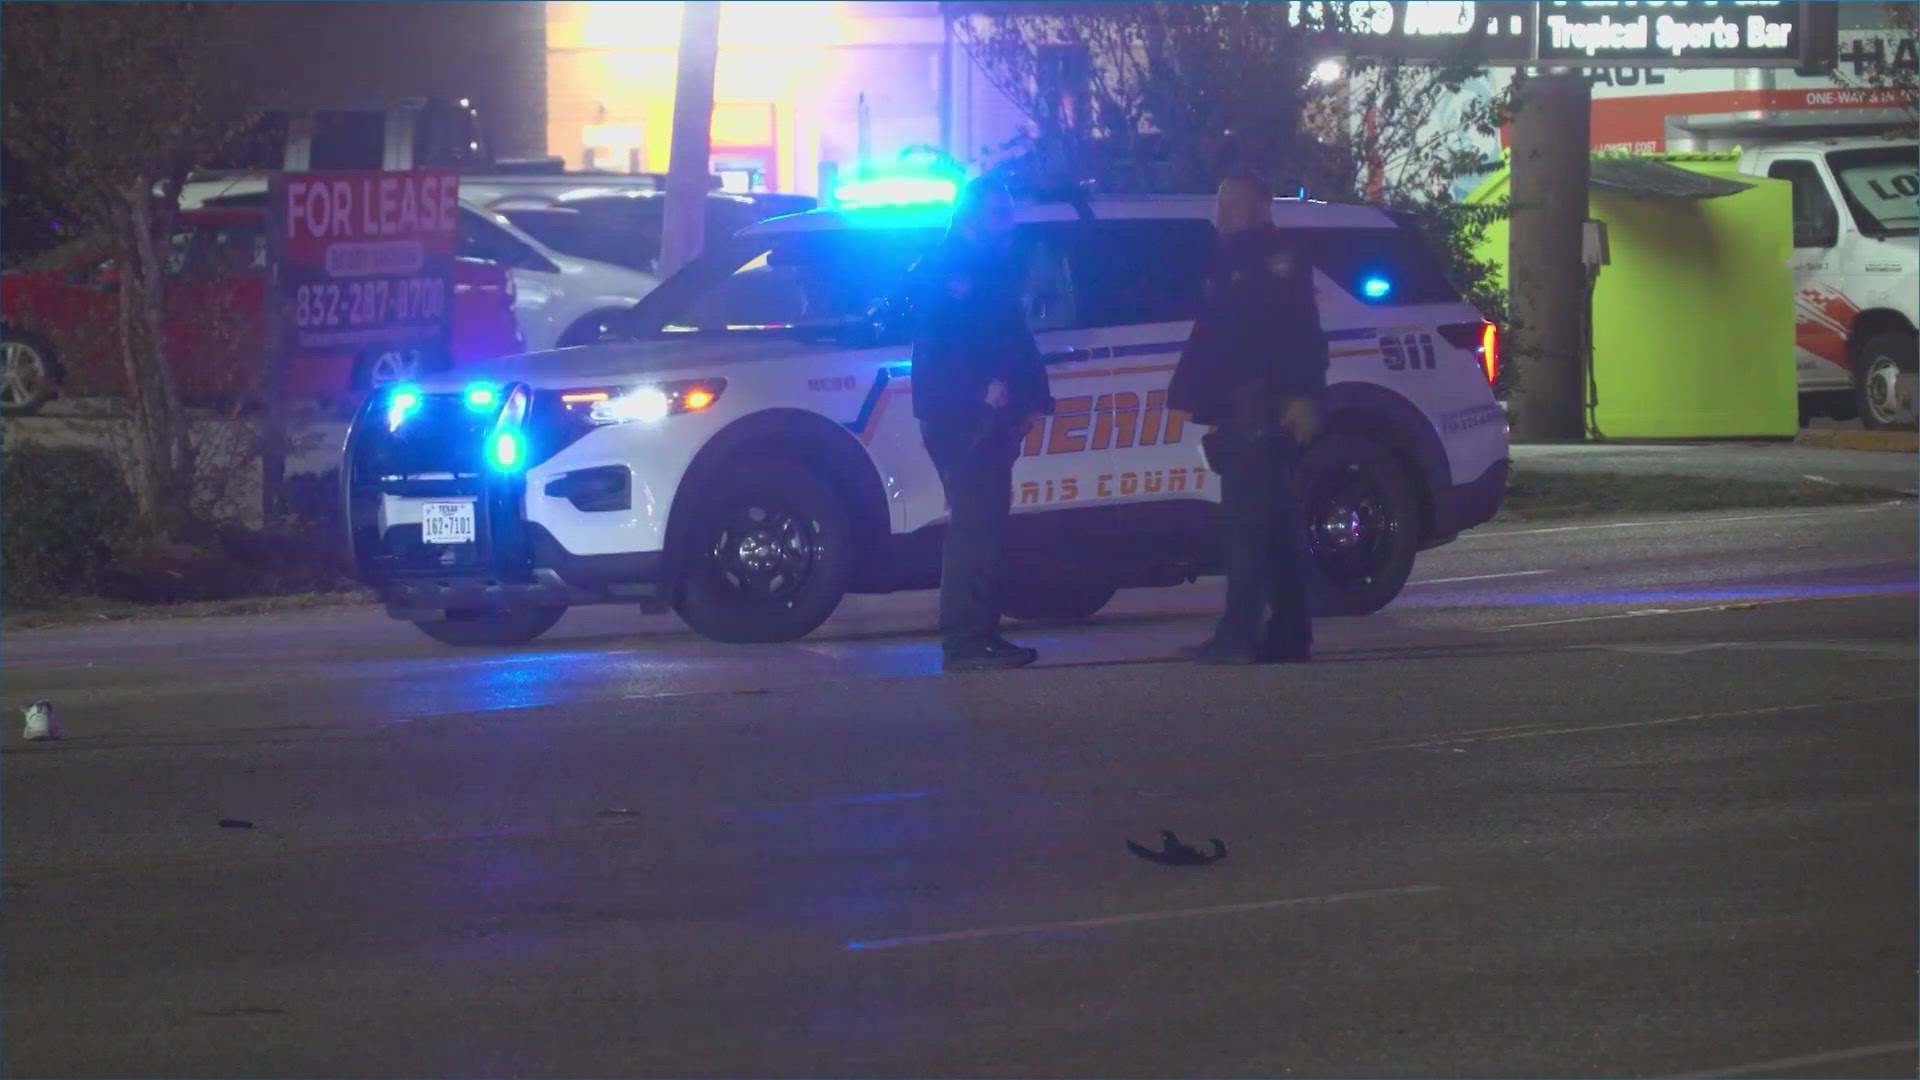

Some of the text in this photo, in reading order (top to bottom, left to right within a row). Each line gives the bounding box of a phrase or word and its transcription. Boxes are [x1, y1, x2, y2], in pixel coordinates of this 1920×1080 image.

[1547, 15, 1647, 56] Tropical
[1656, 15, 1739, 56] Sports
[1747, 15, 1792, 48] Bar
[1867, 172, 1919, 200] LO
[288, 176, 457, 238] FOR LEASE
[1378, 333, 1436, 371] 911
[1097, 467, 1210, 497] COUNT
